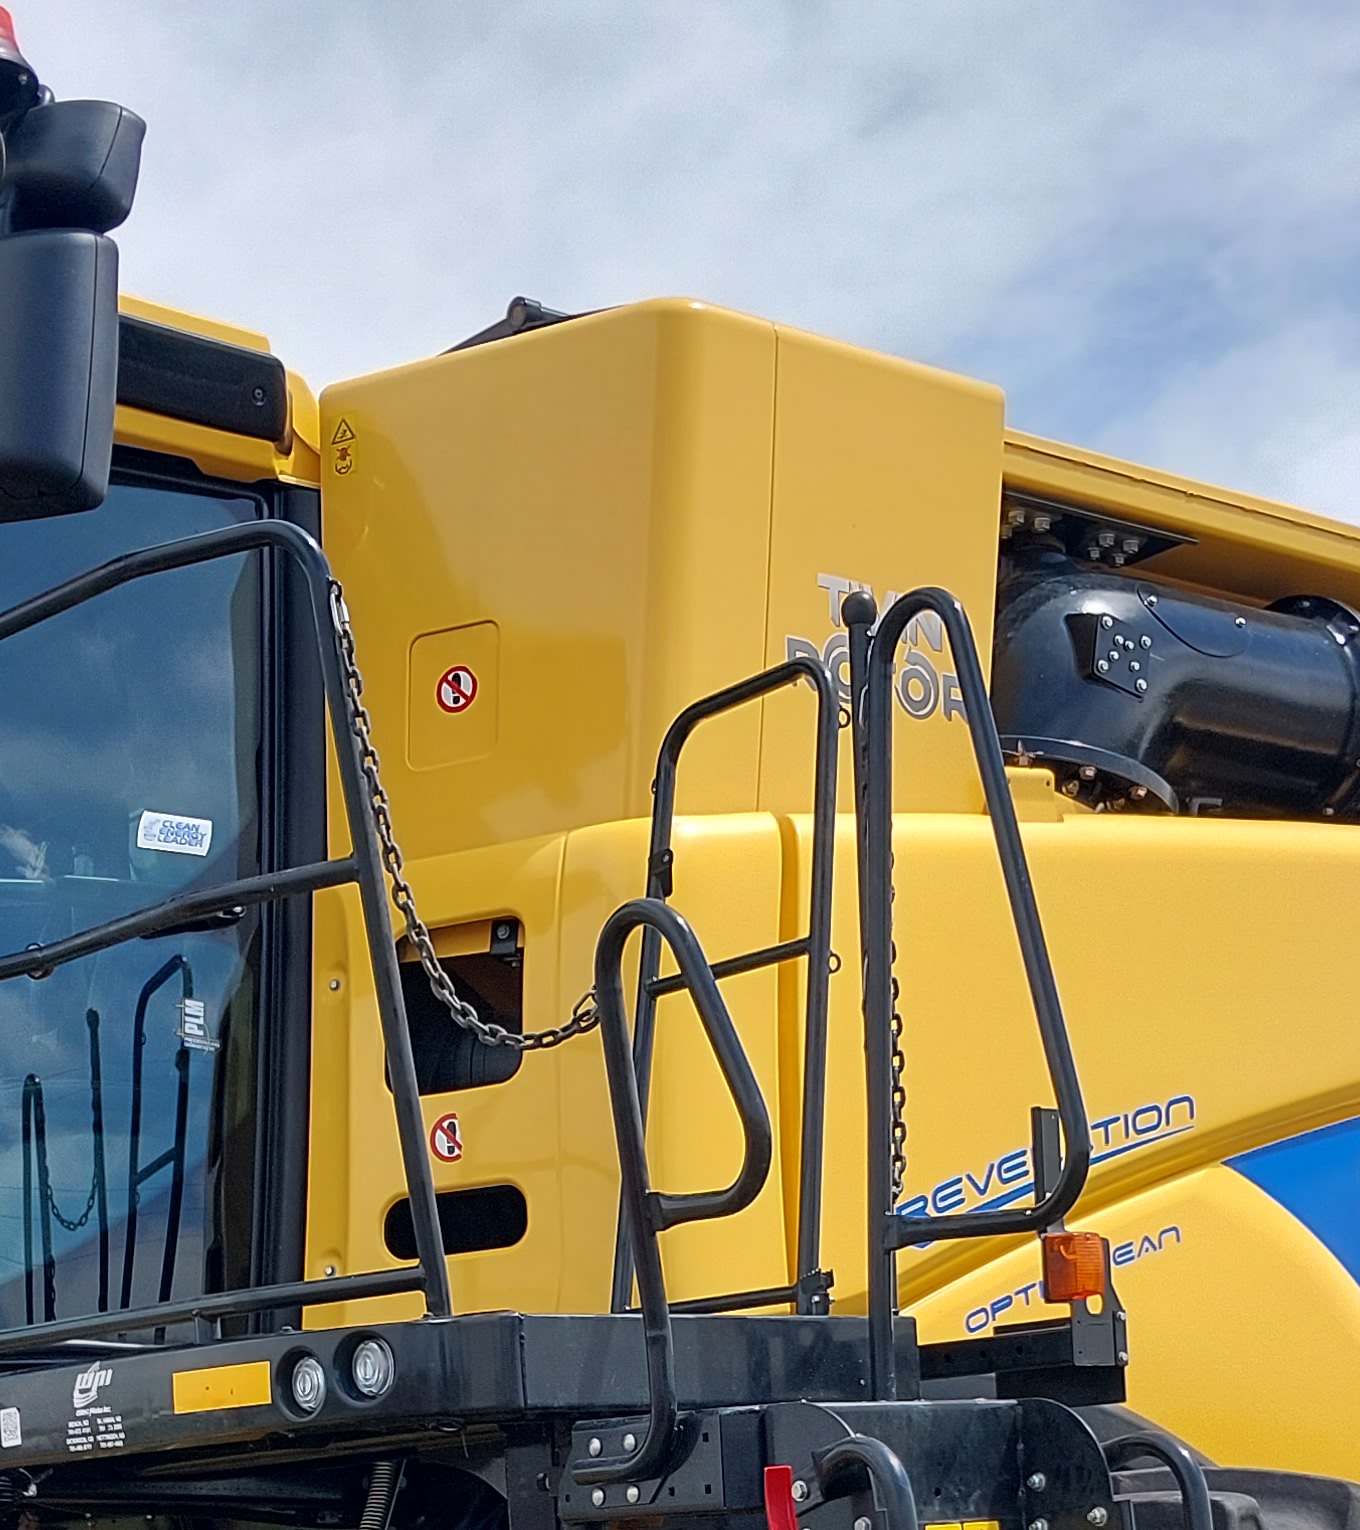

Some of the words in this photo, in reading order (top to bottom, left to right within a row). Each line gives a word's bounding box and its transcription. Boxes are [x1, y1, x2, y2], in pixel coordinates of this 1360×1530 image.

[817, 573, 943, 653] TN
[786, 633, 969, 725] ROOR
[157, 834, 204, 848] LEADER
[159, 827, 207, 841] ENERGY
[162, 820, 201, 832] CLEAN
[896, 1095, 1195, 1223] REVETION
